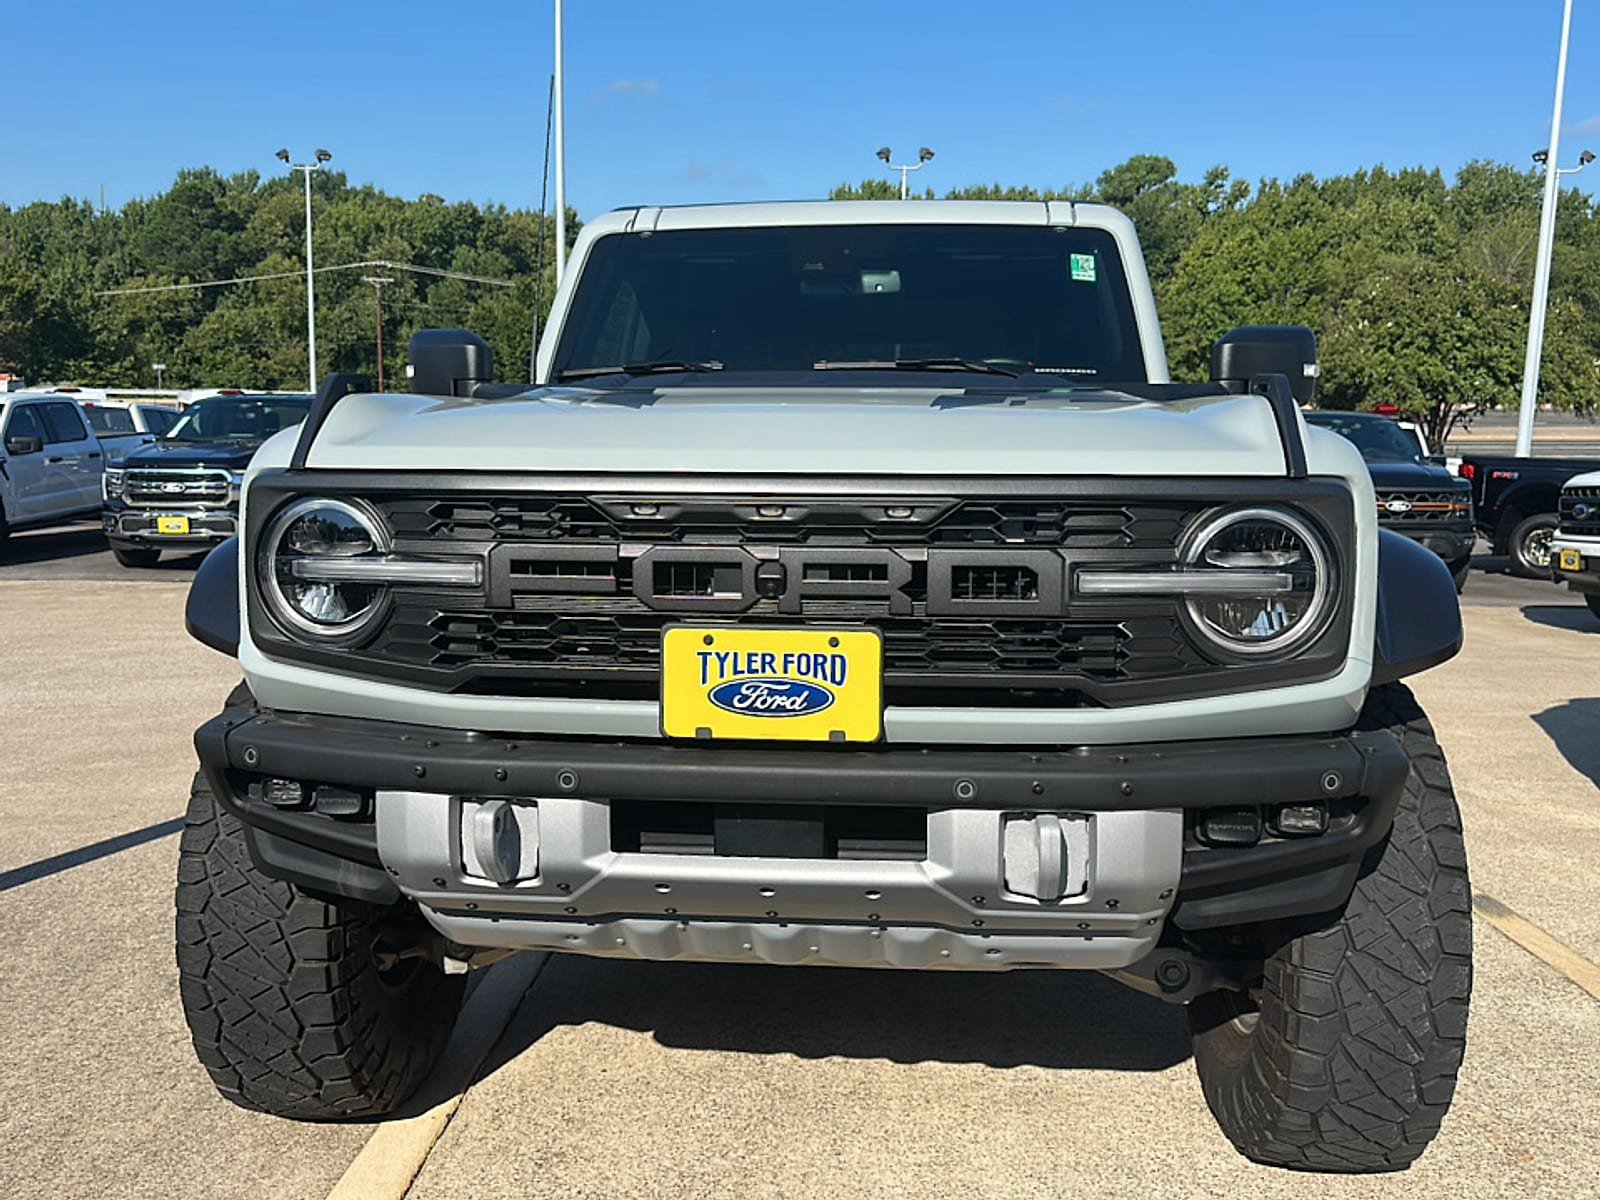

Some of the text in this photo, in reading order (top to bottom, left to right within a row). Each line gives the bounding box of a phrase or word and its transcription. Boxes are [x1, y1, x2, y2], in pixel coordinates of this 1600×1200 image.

[486, 542, 1065, 617] FORD
[697, 651, 848, 687] TYLER FORD
[732, 681, 810, 711] Ford
